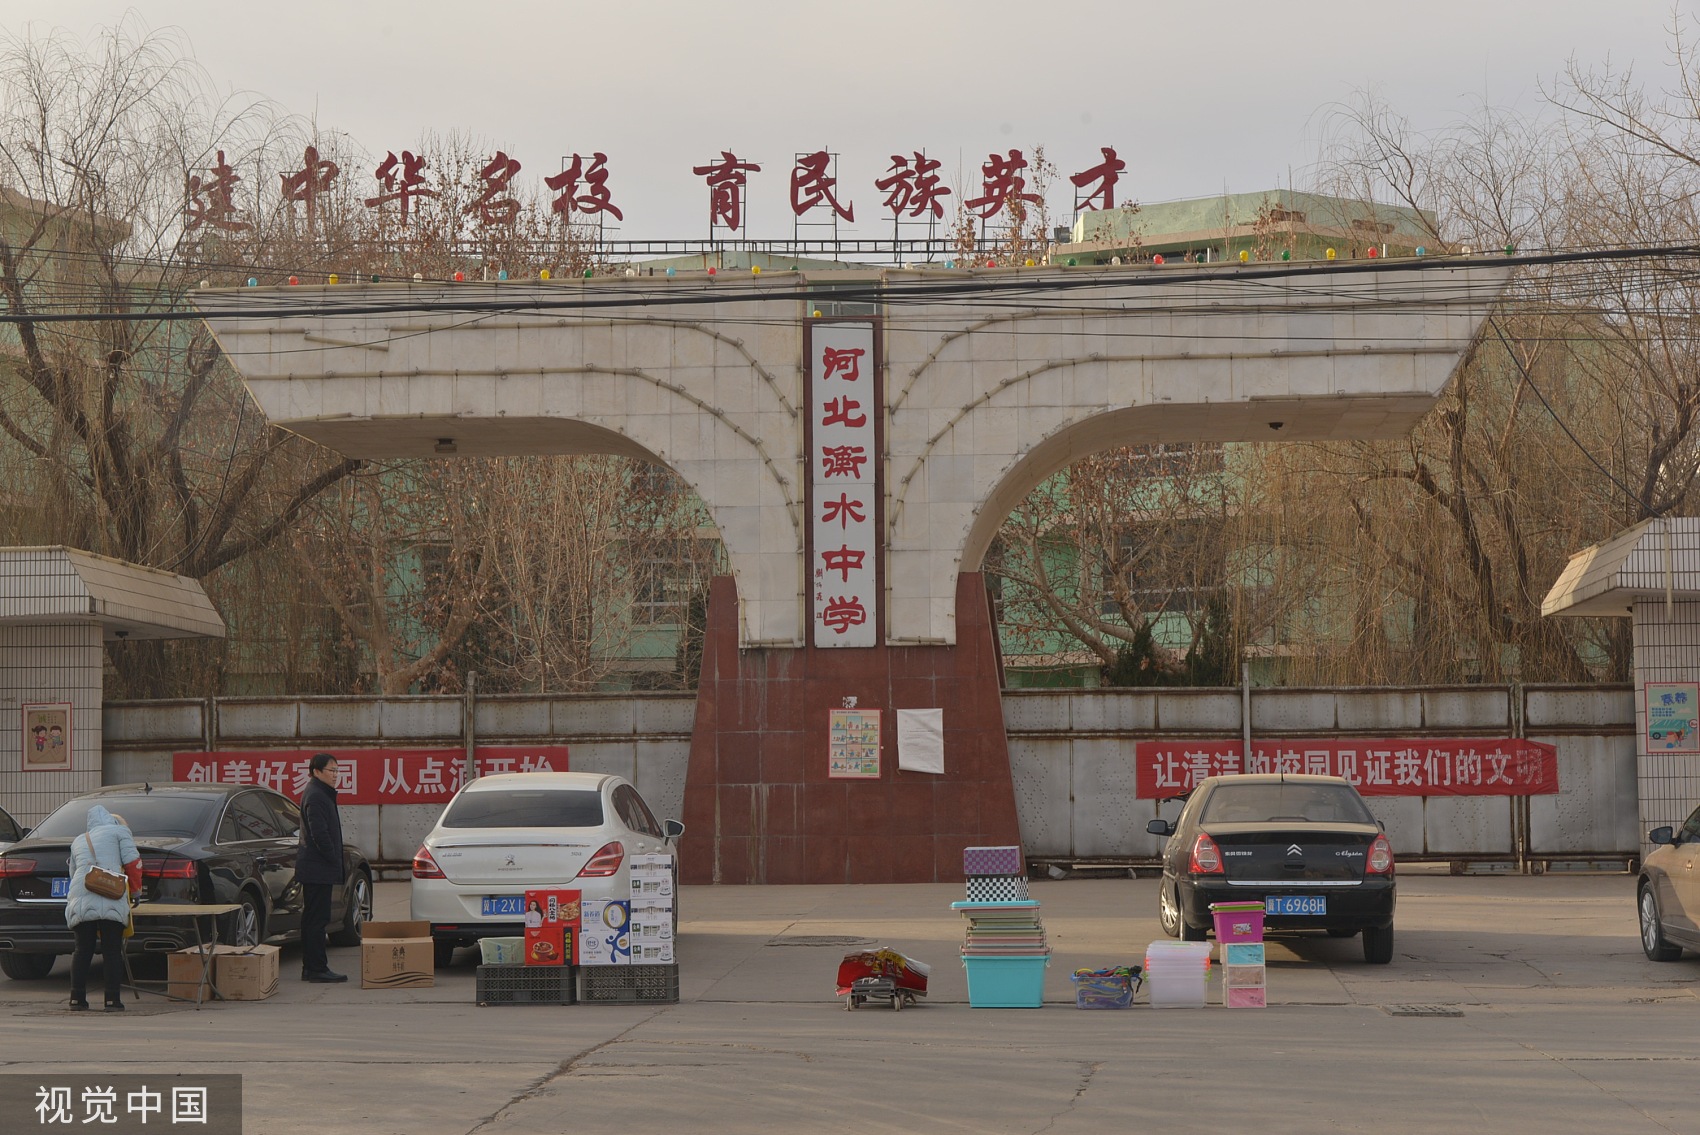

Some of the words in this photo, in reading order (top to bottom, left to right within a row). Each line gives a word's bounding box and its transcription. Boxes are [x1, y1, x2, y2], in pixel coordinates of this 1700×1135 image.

[182, 146, 623, 234] 建中华名校
[693, 147, 1126, 231] 育民族英才
[822, 346, 866, 634] 河北衡水中学
[1153, 748, 1543, 788] 让清洁的校园见证我们的文明
